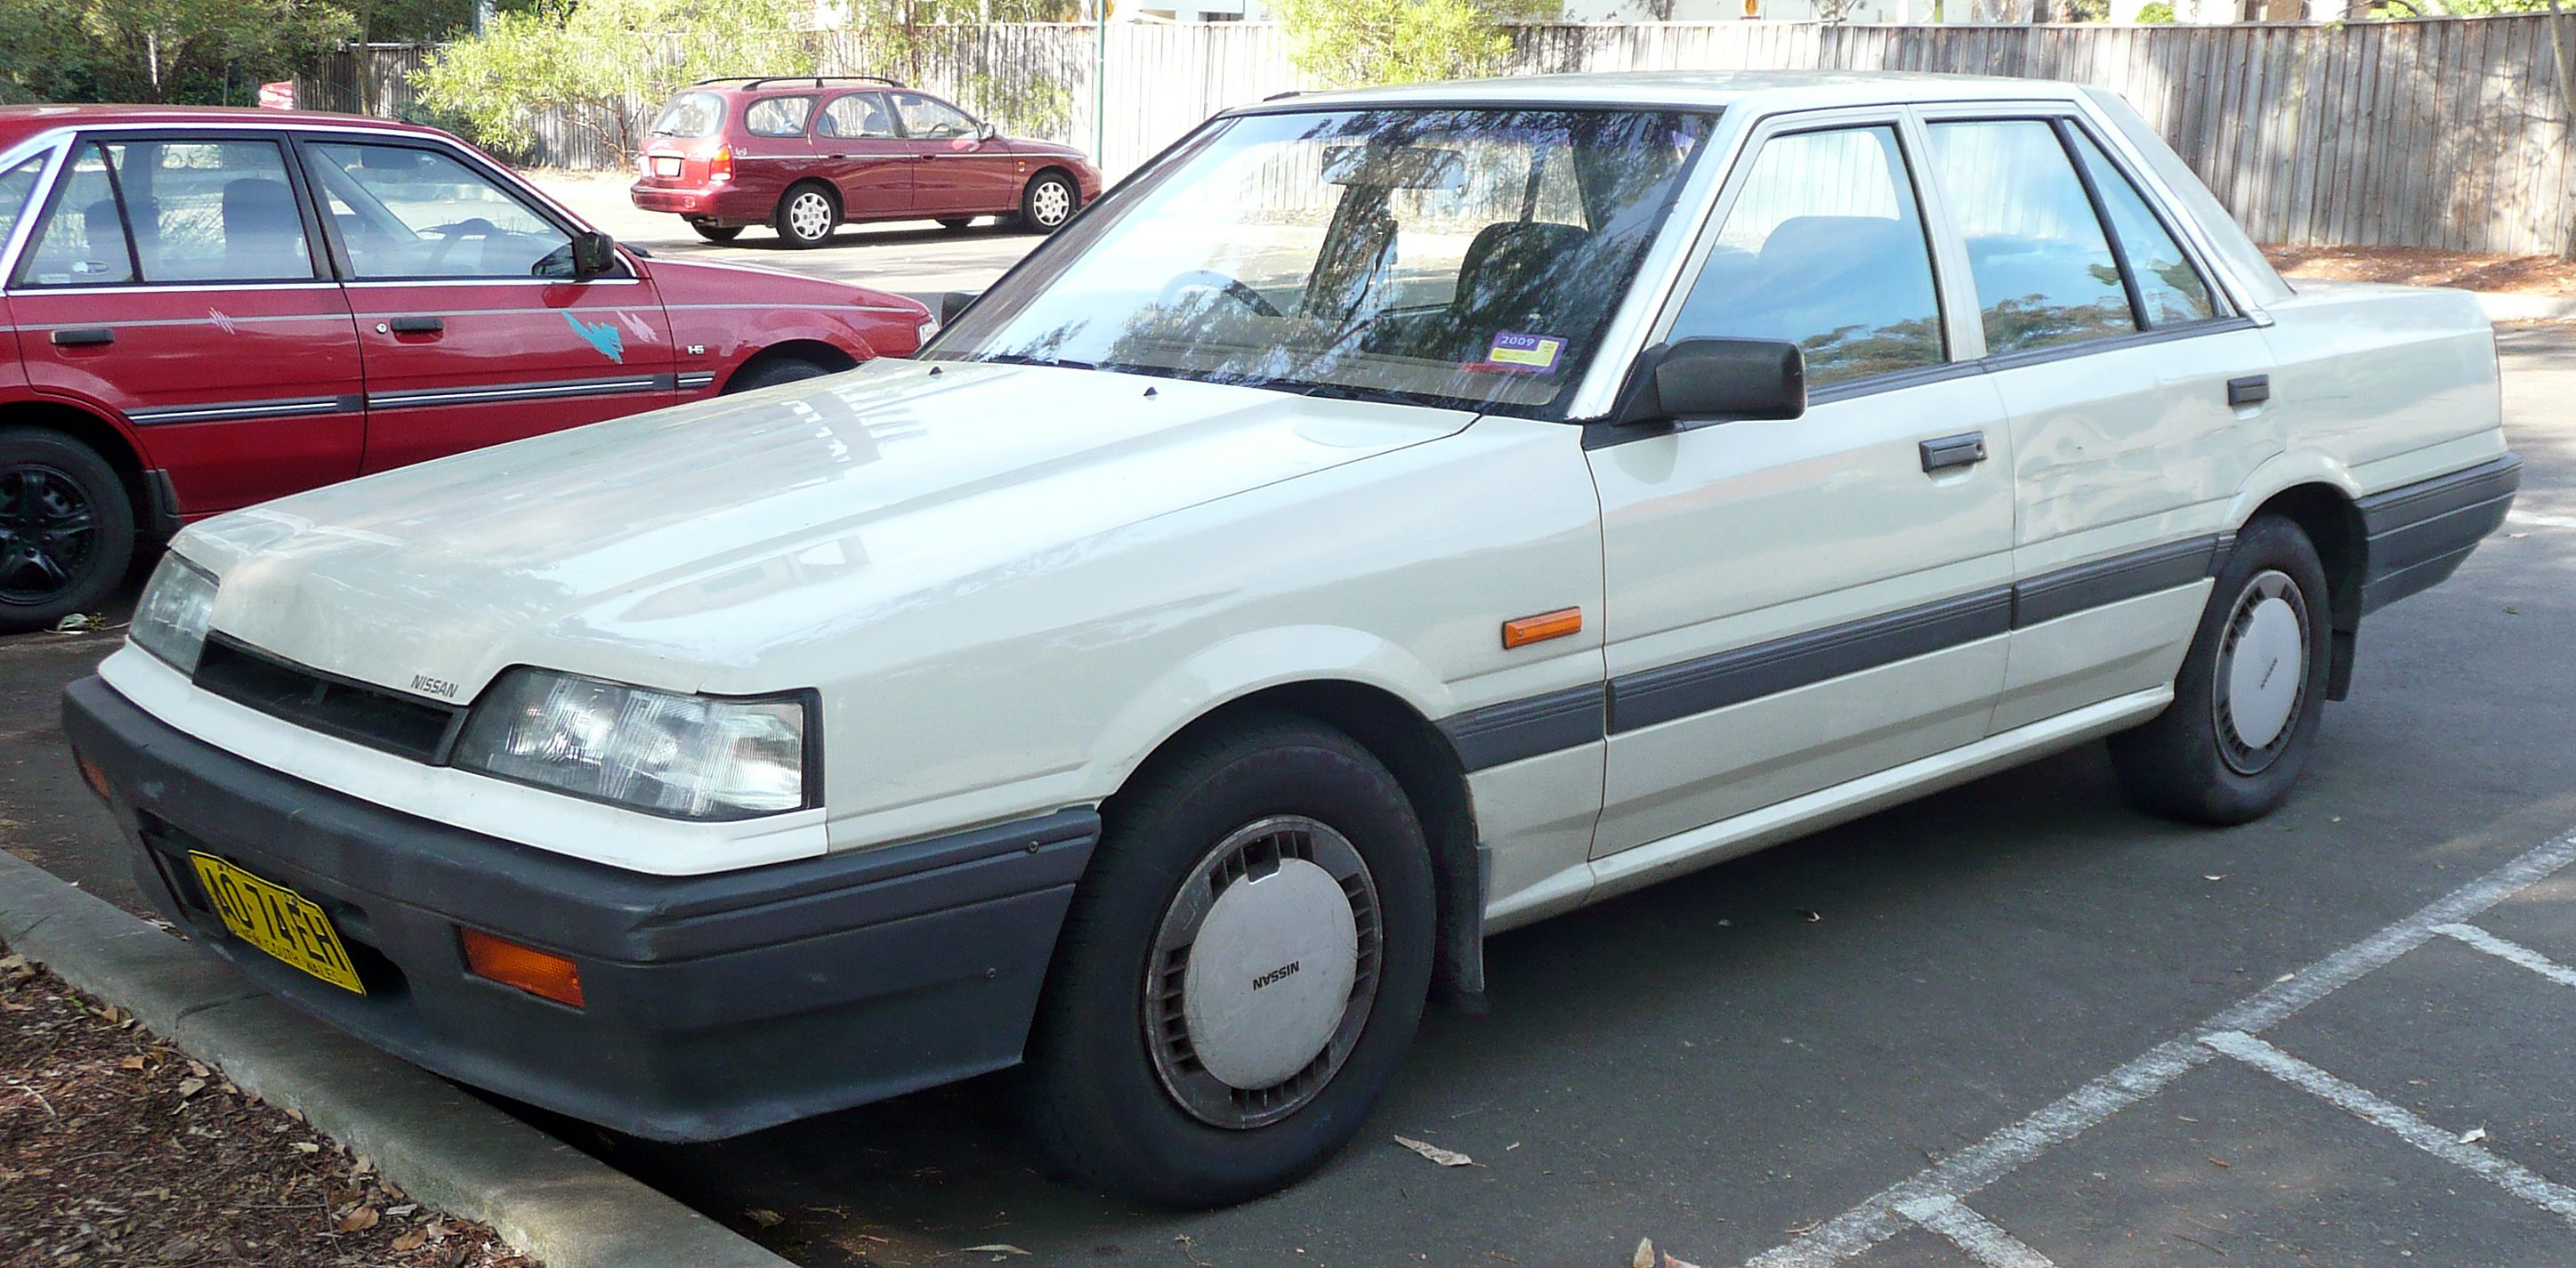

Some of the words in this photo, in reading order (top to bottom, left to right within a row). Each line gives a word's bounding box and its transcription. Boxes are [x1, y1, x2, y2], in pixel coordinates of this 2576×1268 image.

[1500, 336, 1535, 346] 2009
[411, 674, 459, 698] NISSAN
[1253, 961, 1300, 991] NISSAN
